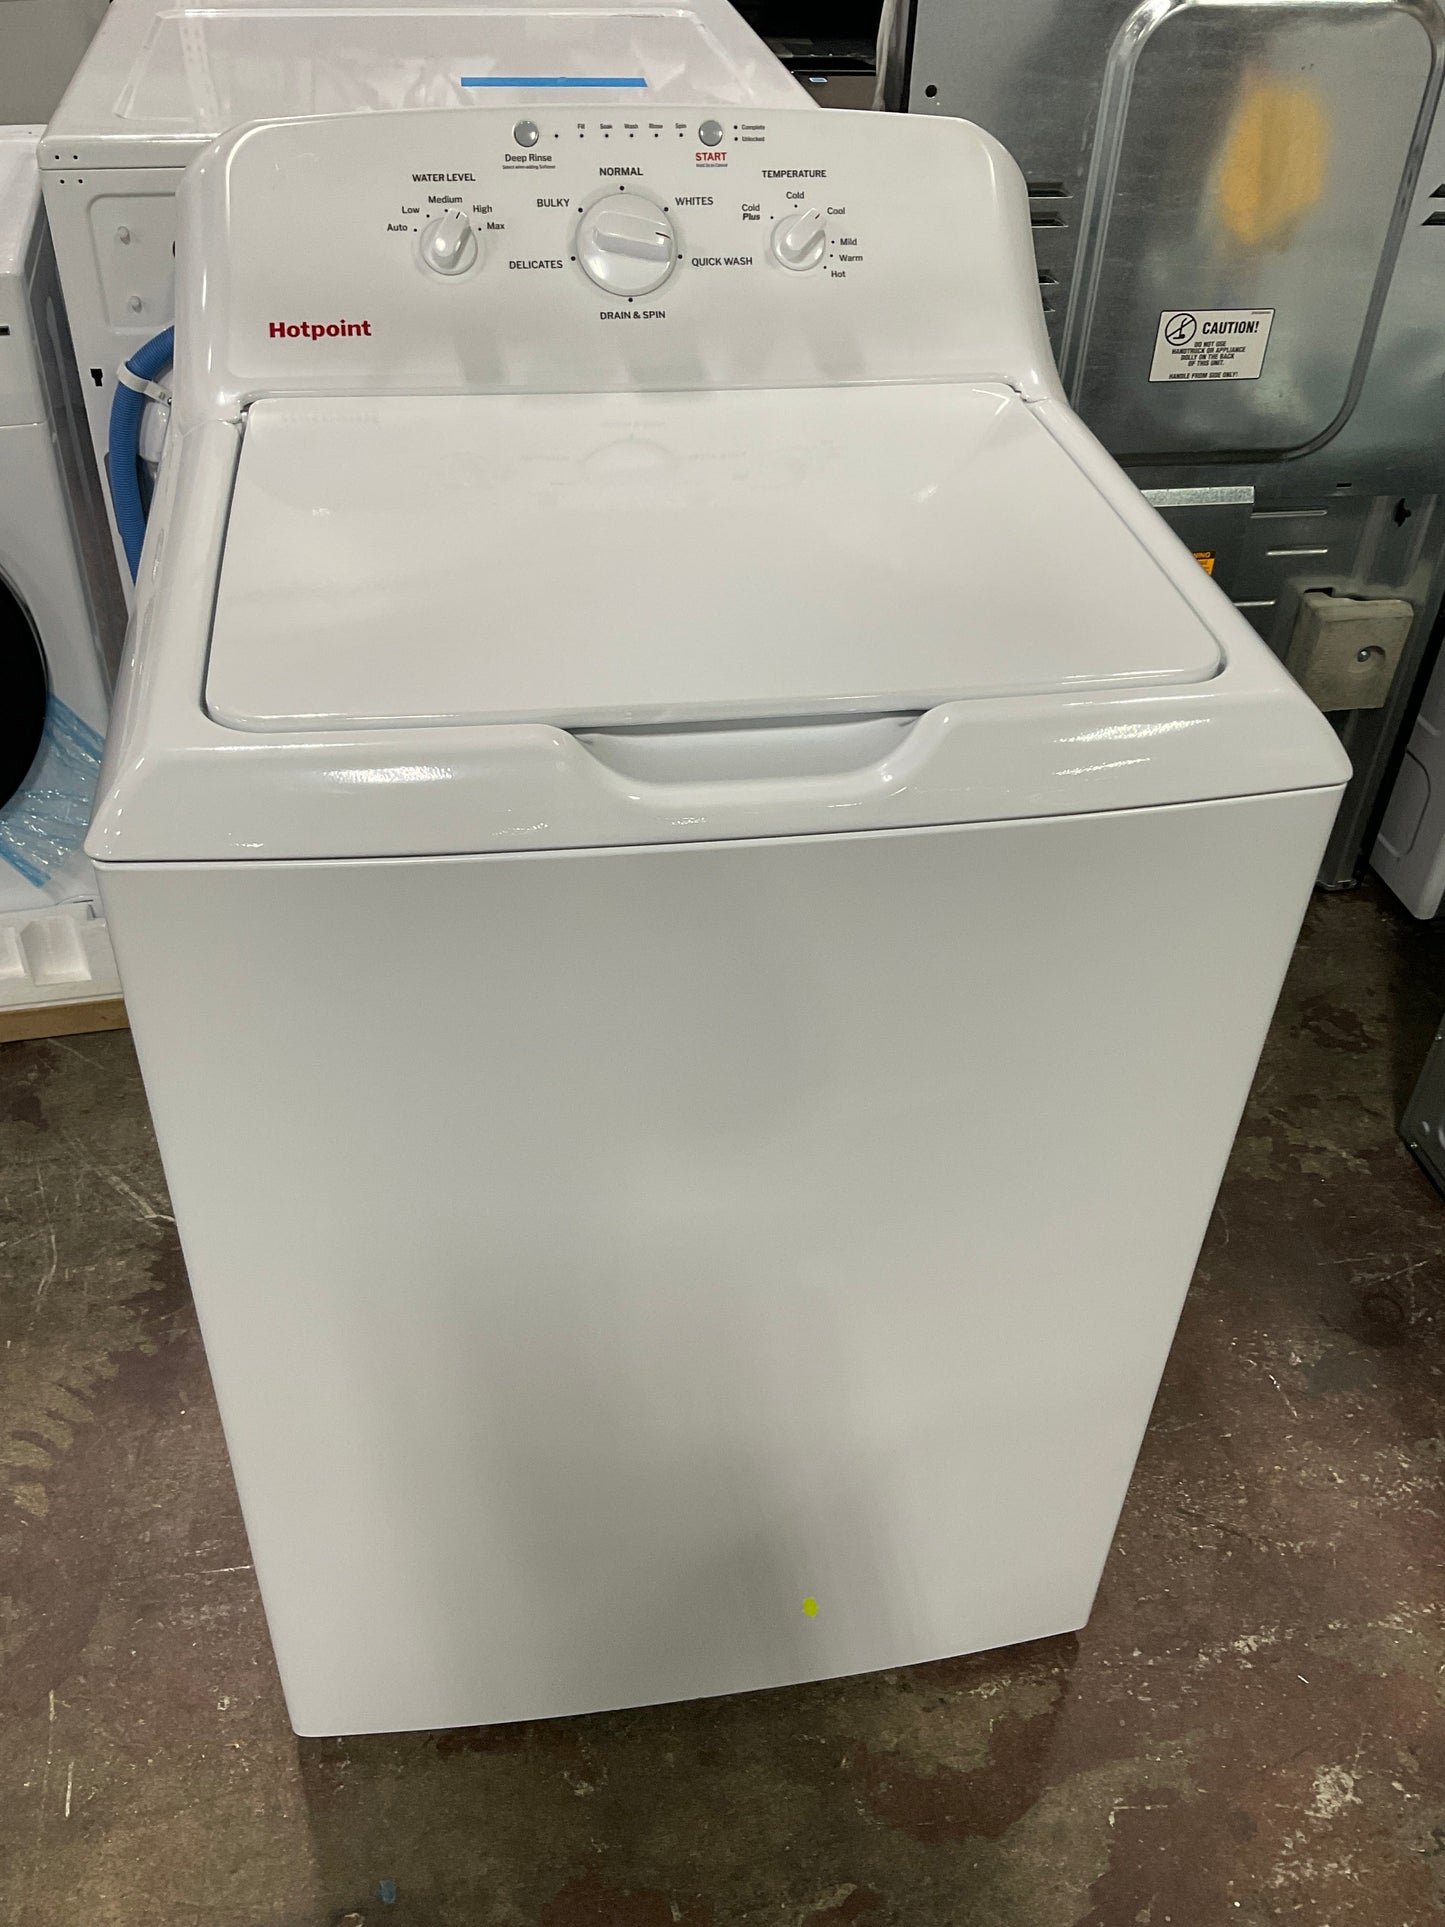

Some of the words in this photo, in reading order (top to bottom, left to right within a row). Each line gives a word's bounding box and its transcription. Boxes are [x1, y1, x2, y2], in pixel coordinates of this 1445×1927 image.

[504, 153, 528, 163] Deep
[528, 153, 553, 162] Rinse
[695, 152, 727, 161] START
[599, 167, 643, 176] NORMAL
[762, 169, 827, 178] TEMPERATURE
[412, 173, 445, 182] WATER
[446, 173, 476, 182] LEVEL
[428, 195, 463, 204] Medium
[786, 191, 805, 199] Cold
[536, 198, 570, 208] BULKY
[675, 196, 714, 206] WHITES
[401, 206, 420, 214] Low
[473, 205, 493, 215] High
[741, 203, 760, 212] Cold
[827, 207, 846, 215] Cool
[742, 213, 761, 221] Plus
[387, 224, 408, 232] Auto
[486, 222, 505, 230] Max
[840, 238, 858, 246] Mild
[691, 257, 722, 267] QUICK
[723, 257, 753, 266] WASH
[839, 254, 863, 262] Warm
[509, 260, 563, 270] DELICATES
[830, 270, 846, 278] Hot
[600, 311, 631, 320] DRAIN
[632, 311, 642, 319] &
[642, 311, 666, 319] SPIN
[269, 319, 372, 341] Hotpoint
[1202, 321, 1259, 334] CAUTION!
